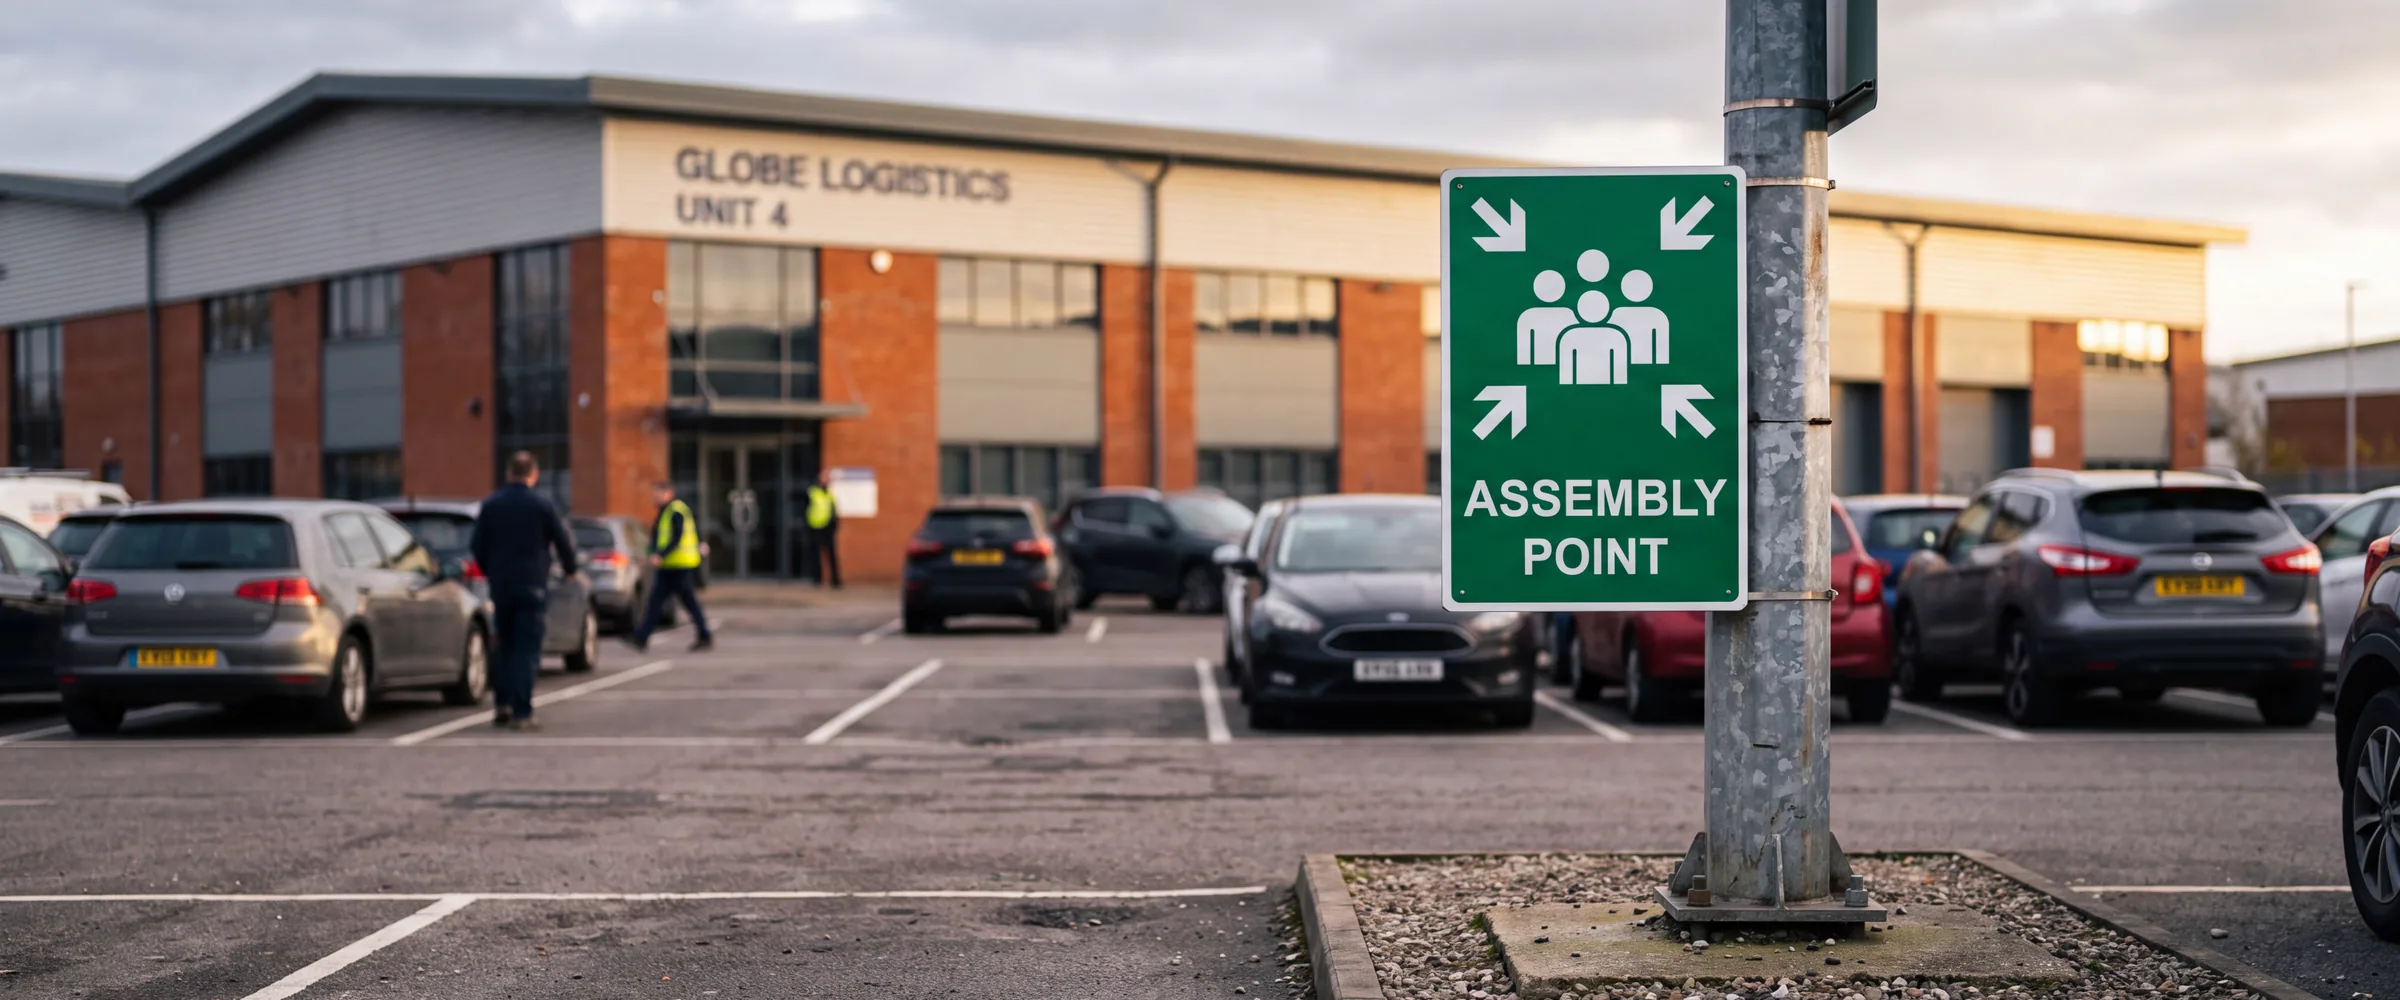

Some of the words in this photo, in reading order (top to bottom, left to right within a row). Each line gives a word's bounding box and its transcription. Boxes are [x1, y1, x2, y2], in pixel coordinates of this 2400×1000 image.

[676, 147, 809, 188] GLOBE
[821, 157, 1011, 203] LOGISTICS
[676, 194, 758, 226] UNIT
[770, 200, 789, 228] 4
[1463, 478, 1728, 517] ASSEMBLY
[1524, 537, 1668, 575] POINT
